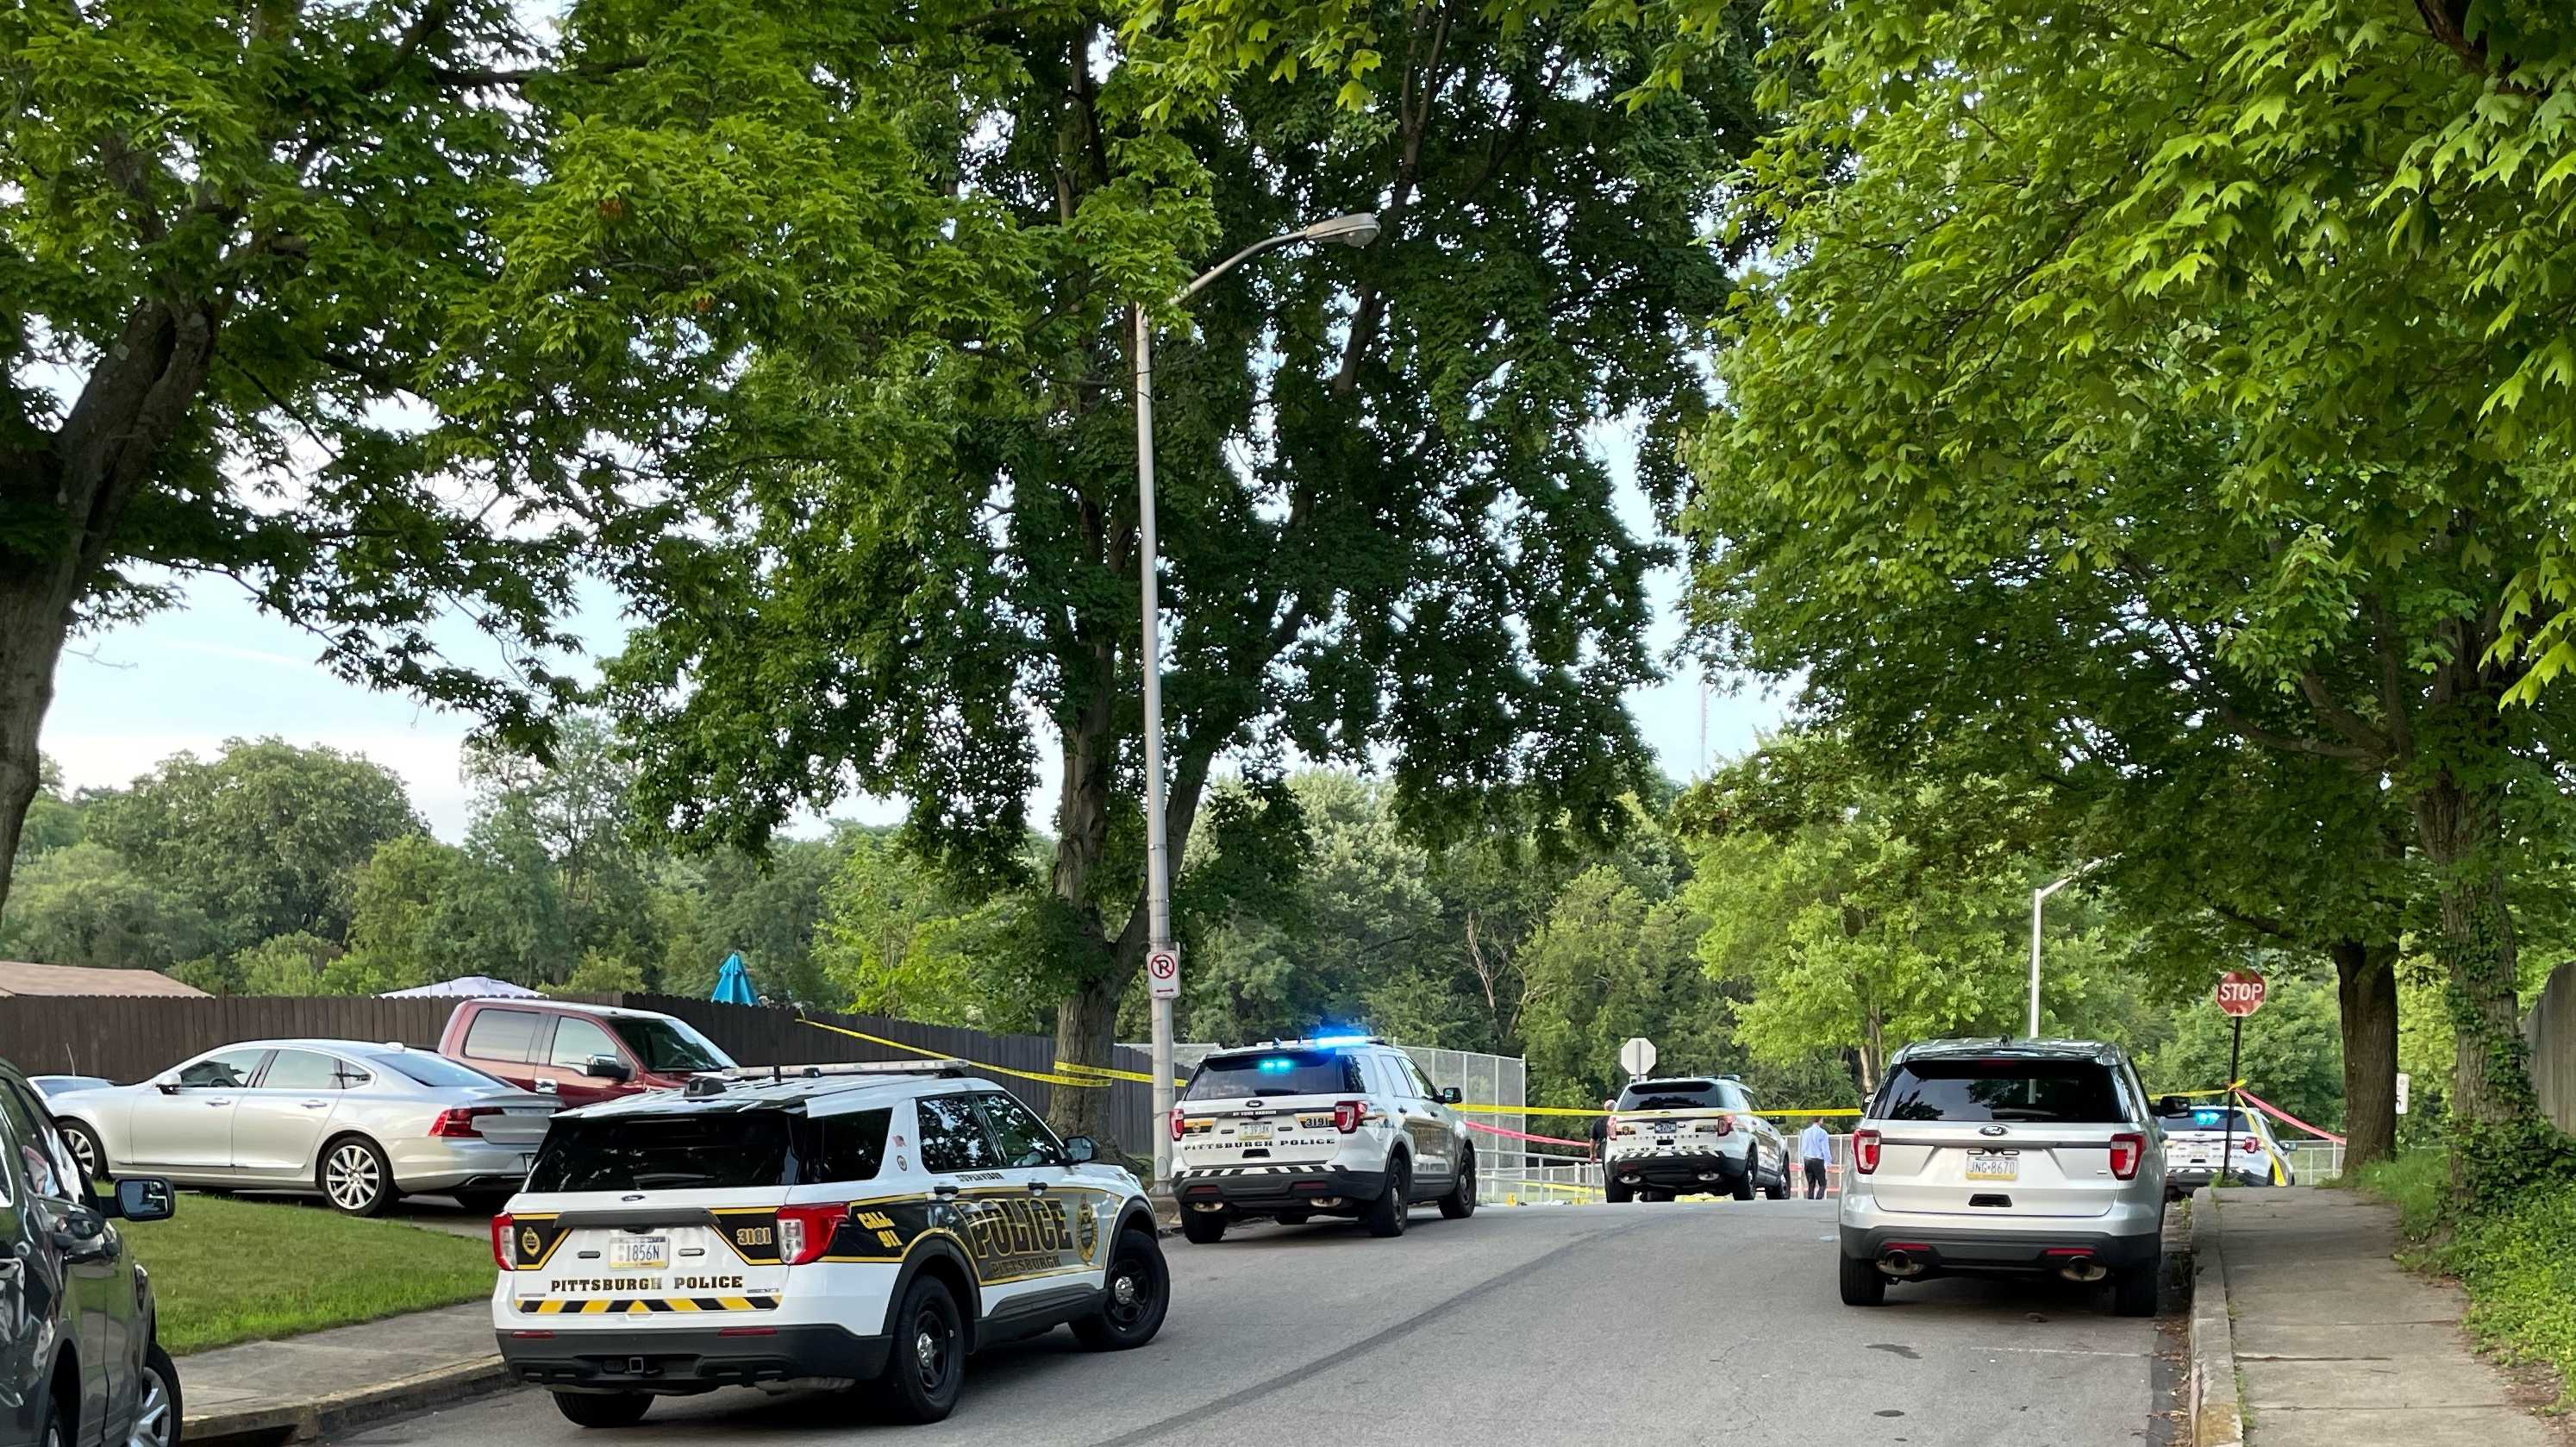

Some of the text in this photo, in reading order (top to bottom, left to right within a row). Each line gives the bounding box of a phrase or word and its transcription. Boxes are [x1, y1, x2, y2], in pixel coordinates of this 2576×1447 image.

[2220, 983, 2263, 1000] STOP
[1305, 1117, 1330, 1127] 3191
[1185, 1141, 1273, 1150] PITTSBURGH
[857, 1211, 896, 1230] CALL
[952, 1198, 1073, 1259] POLICE
[877, 1230, 903, 1248] 911
[991, 1256, 1062, 1274] PITTSBURGH
[551, 1275, 743, 1292] PITTSBURGH POLICE
